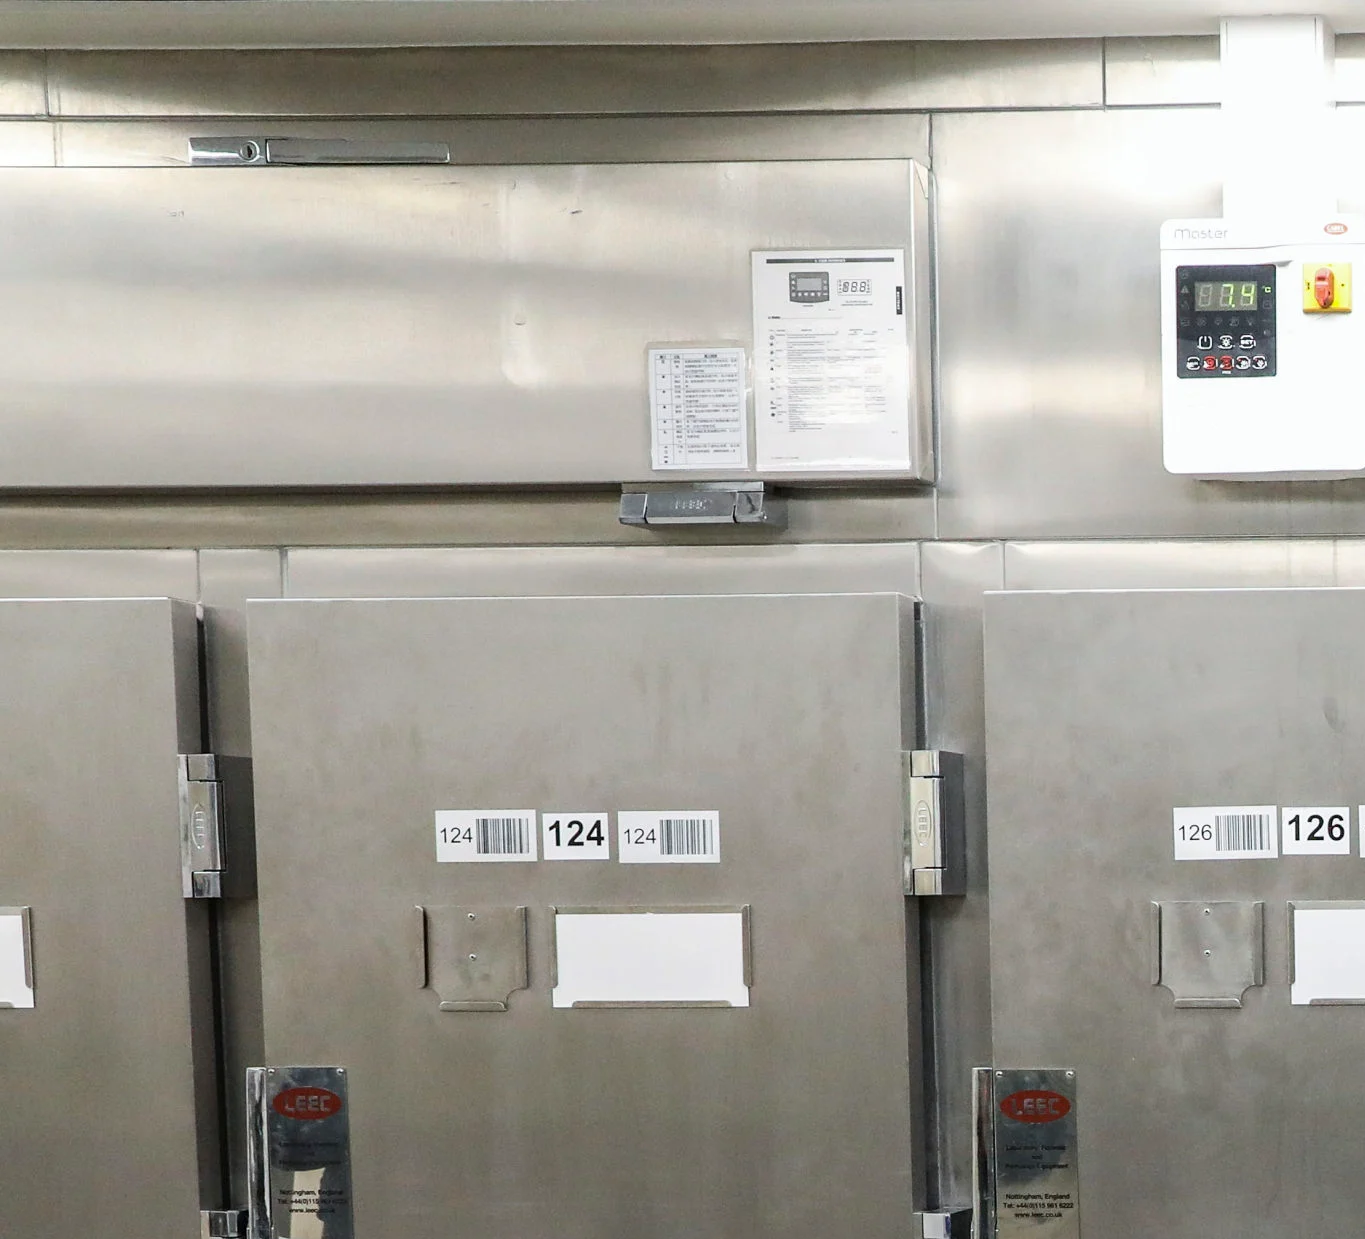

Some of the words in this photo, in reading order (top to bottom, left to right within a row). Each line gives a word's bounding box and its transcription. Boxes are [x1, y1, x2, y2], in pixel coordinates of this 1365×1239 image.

[439, 827, 473, 844] 124
[548, 820, 605, 847] 124
[1179, 824, 1212, 841] 126
[1287, 814, 1345, 841] 126
[623, 828, 657, 845] 124
[284, 1096, 331, 1112] LEEC
[1011, 1098, 1060, 1115] LEEC
